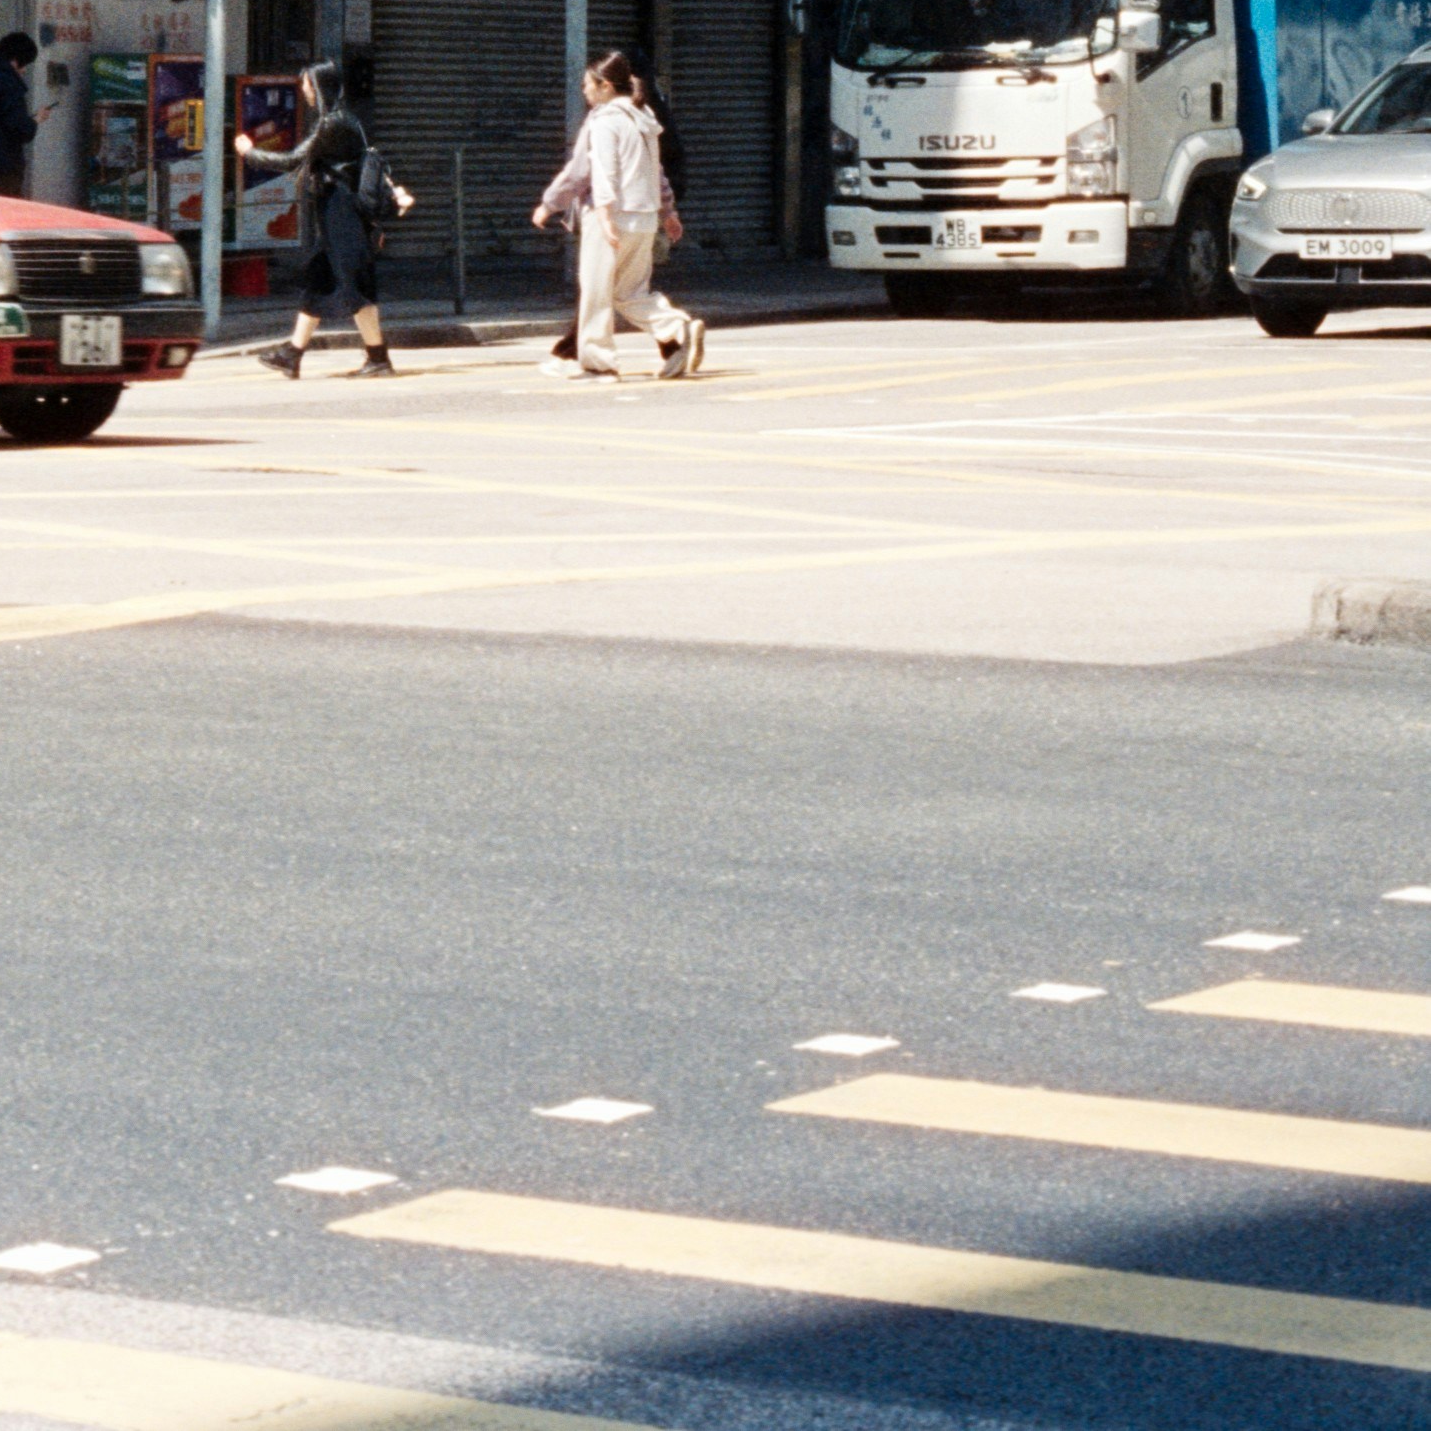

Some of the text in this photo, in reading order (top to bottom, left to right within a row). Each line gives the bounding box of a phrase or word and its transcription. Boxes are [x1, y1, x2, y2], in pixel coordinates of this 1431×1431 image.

[918, 134, 996, 151] ISUZU
[945, 219, 967, 233] WB
[1306, 239, 1386, 256] EM 3009
